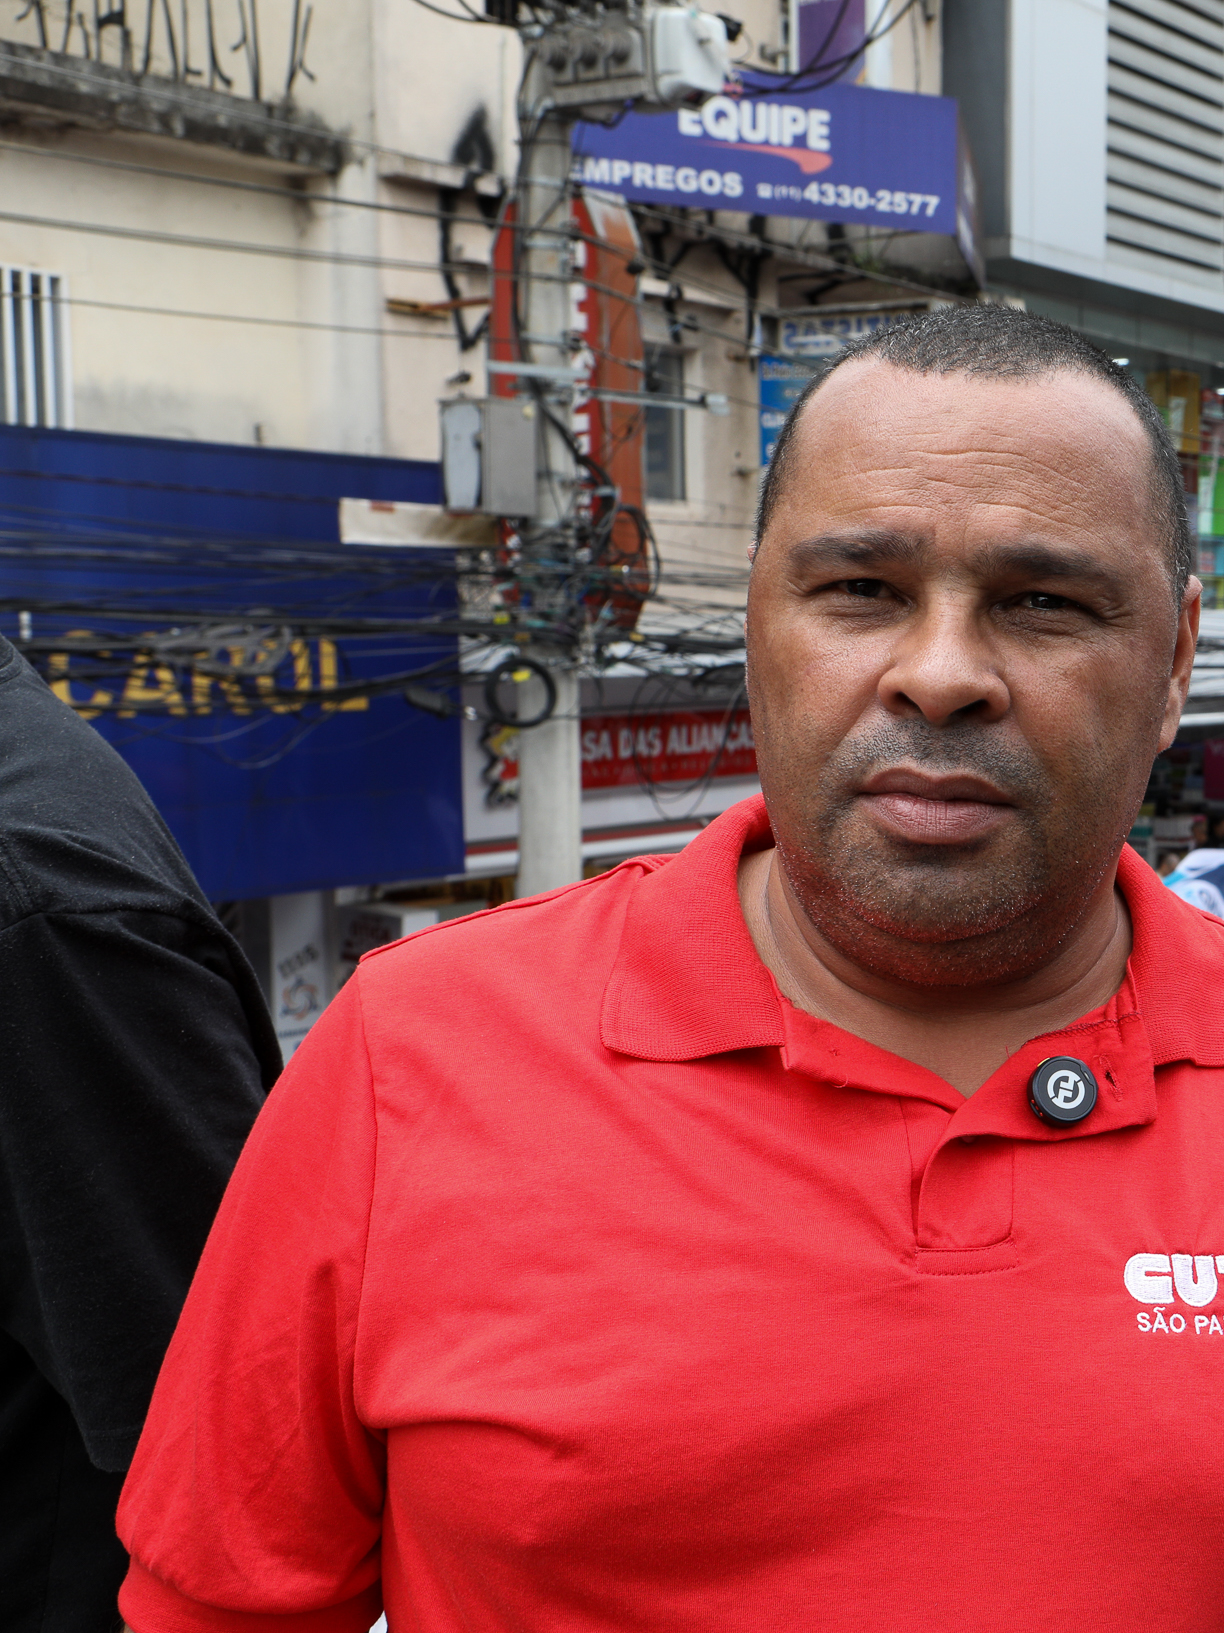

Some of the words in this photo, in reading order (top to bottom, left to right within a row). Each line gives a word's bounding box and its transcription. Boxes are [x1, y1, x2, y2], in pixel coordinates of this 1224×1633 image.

[677, 96, 832, 151] EQUIPE
[802, 181, 941, 218] 4330-2577
[1136, 1306, 1187, 1334] SÃO
